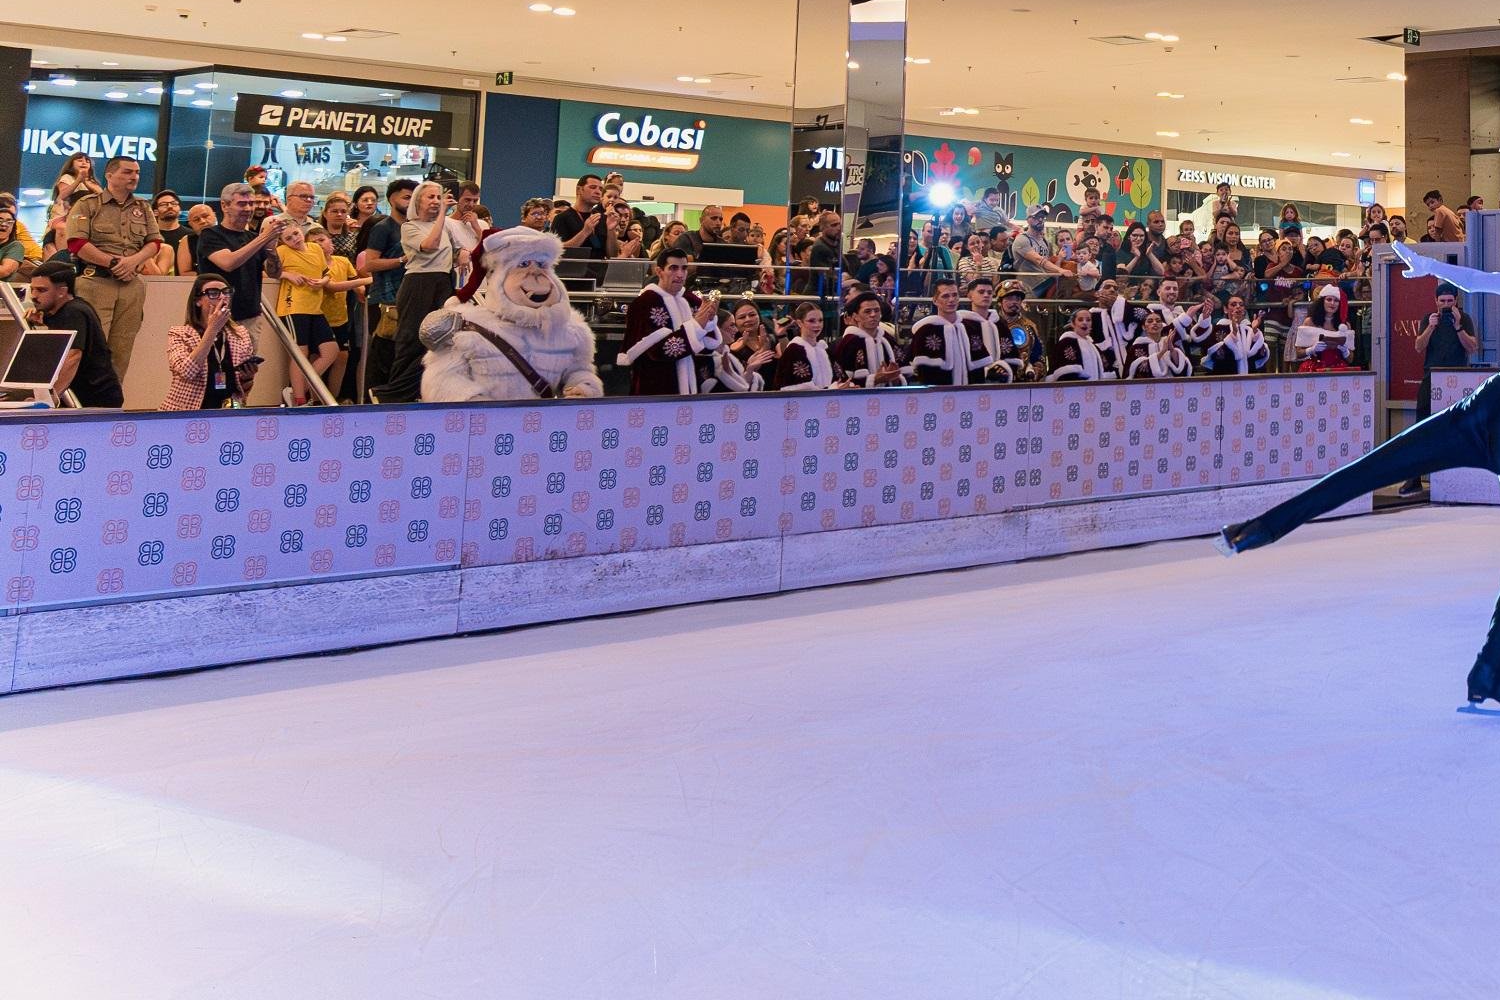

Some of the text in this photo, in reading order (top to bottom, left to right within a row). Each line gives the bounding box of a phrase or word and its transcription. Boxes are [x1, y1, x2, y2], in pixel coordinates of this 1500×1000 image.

[286, 107, 434, 138] PLANETA SURF
[597, 112, 706, 150] Cobasi
[294, 140, 332, 165] VANS
[1178, 168, 1276, 190] ZEISS VISION CENTER
